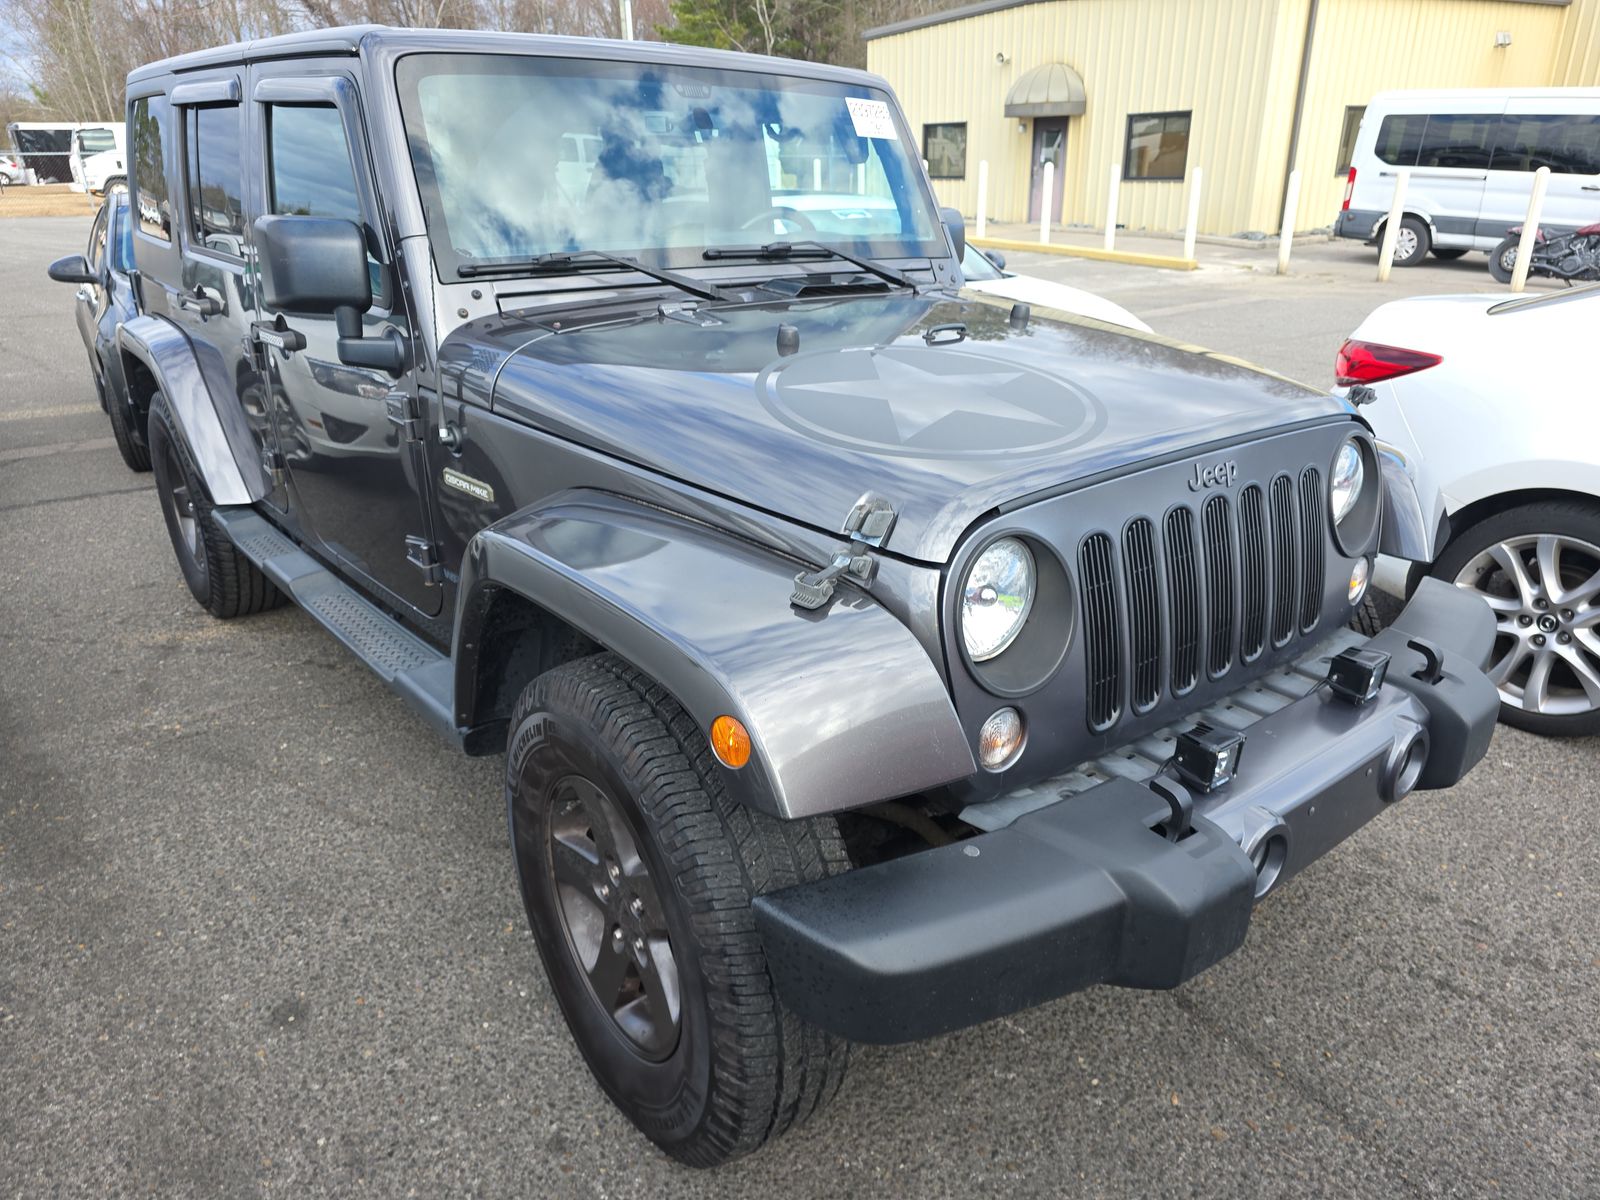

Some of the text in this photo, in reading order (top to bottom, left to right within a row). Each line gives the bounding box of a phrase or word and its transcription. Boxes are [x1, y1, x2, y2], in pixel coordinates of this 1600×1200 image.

[445, 473, 489, 499] OSCAR MIKE
[1188, 460, 1238, 492] Jeep
[512, 722, 543, 763] MICHELIN
